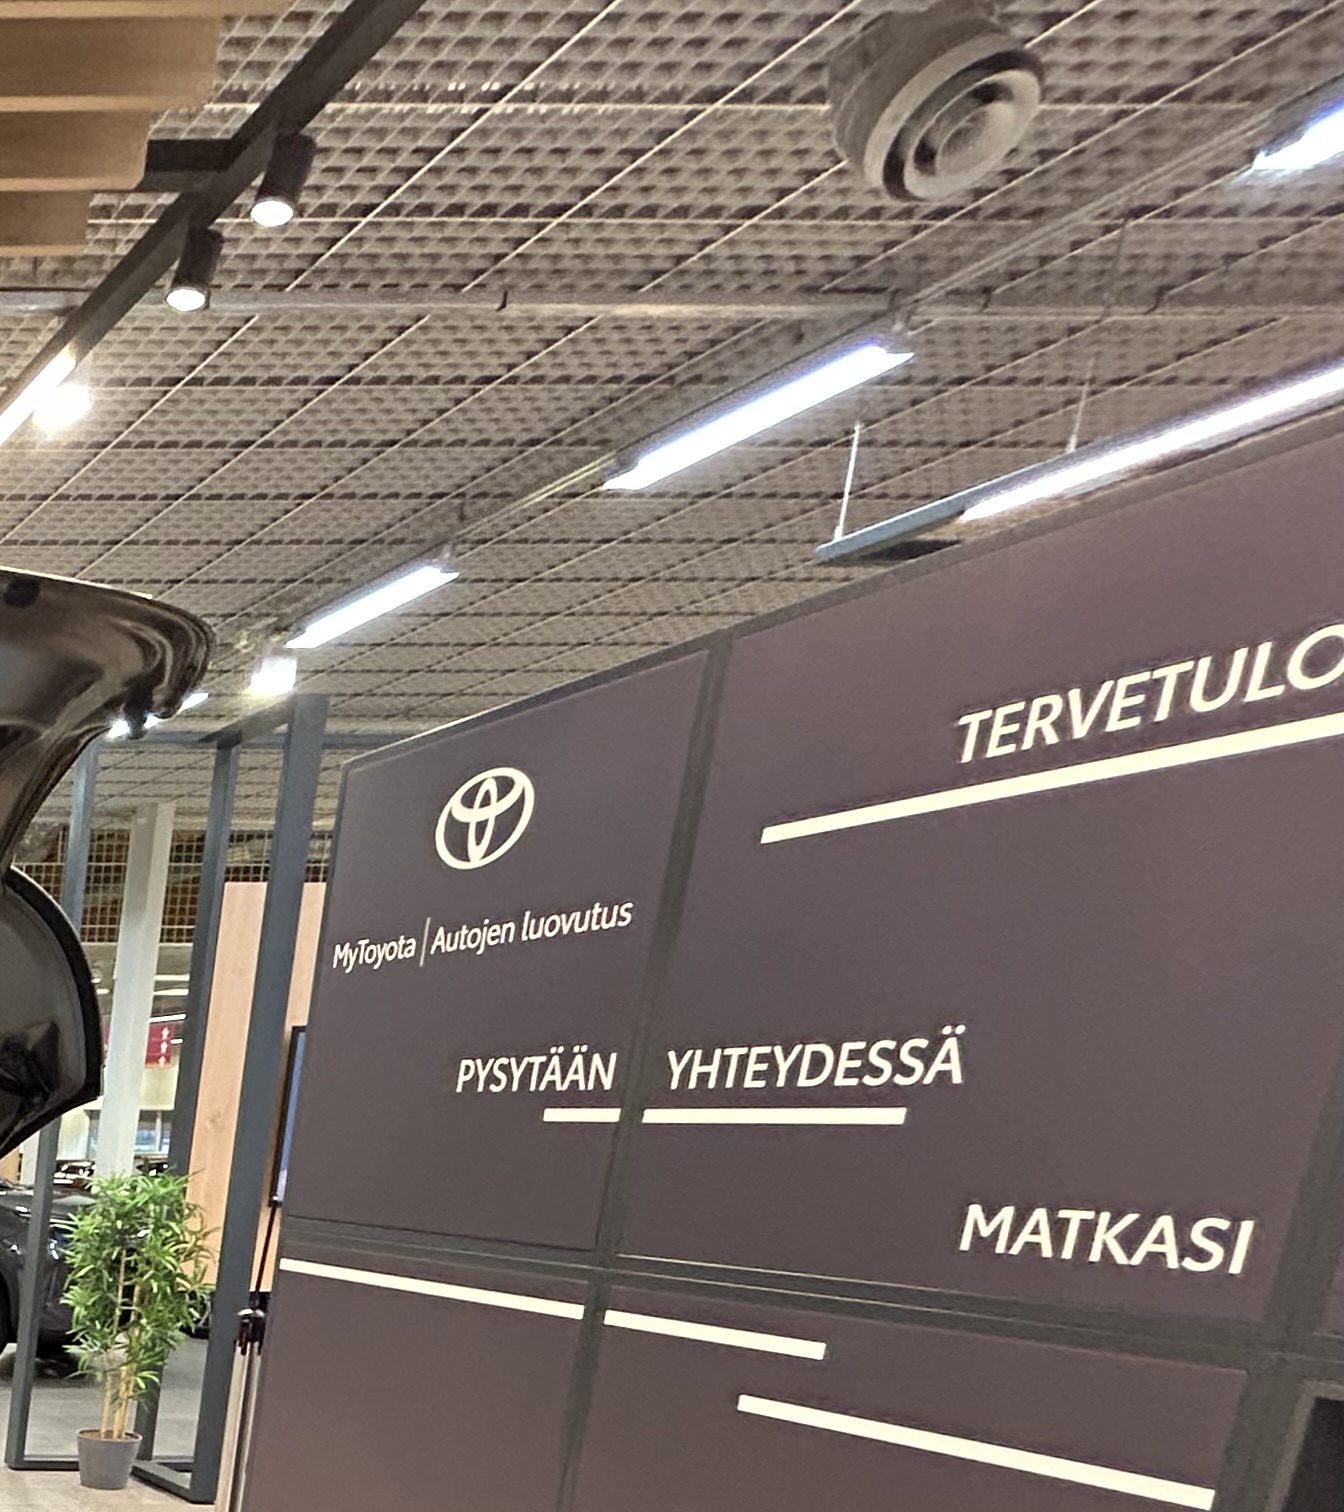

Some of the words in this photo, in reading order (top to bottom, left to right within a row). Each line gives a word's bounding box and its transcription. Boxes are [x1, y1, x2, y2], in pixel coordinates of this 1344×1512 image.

[957, 623, 1344, 764] TERVETULO
[332, 935, 417, 974] MyToyota
[429, 918, 515, 955] Autojen
[520, 900, 634, 942] luovutus
[455, 1044, 617, 1093] PYSYTÄÄN
[666, 1023, 967, 1091] YHTEYDESSÄ
[958, 1203, 1255, 1275] MATKASI
